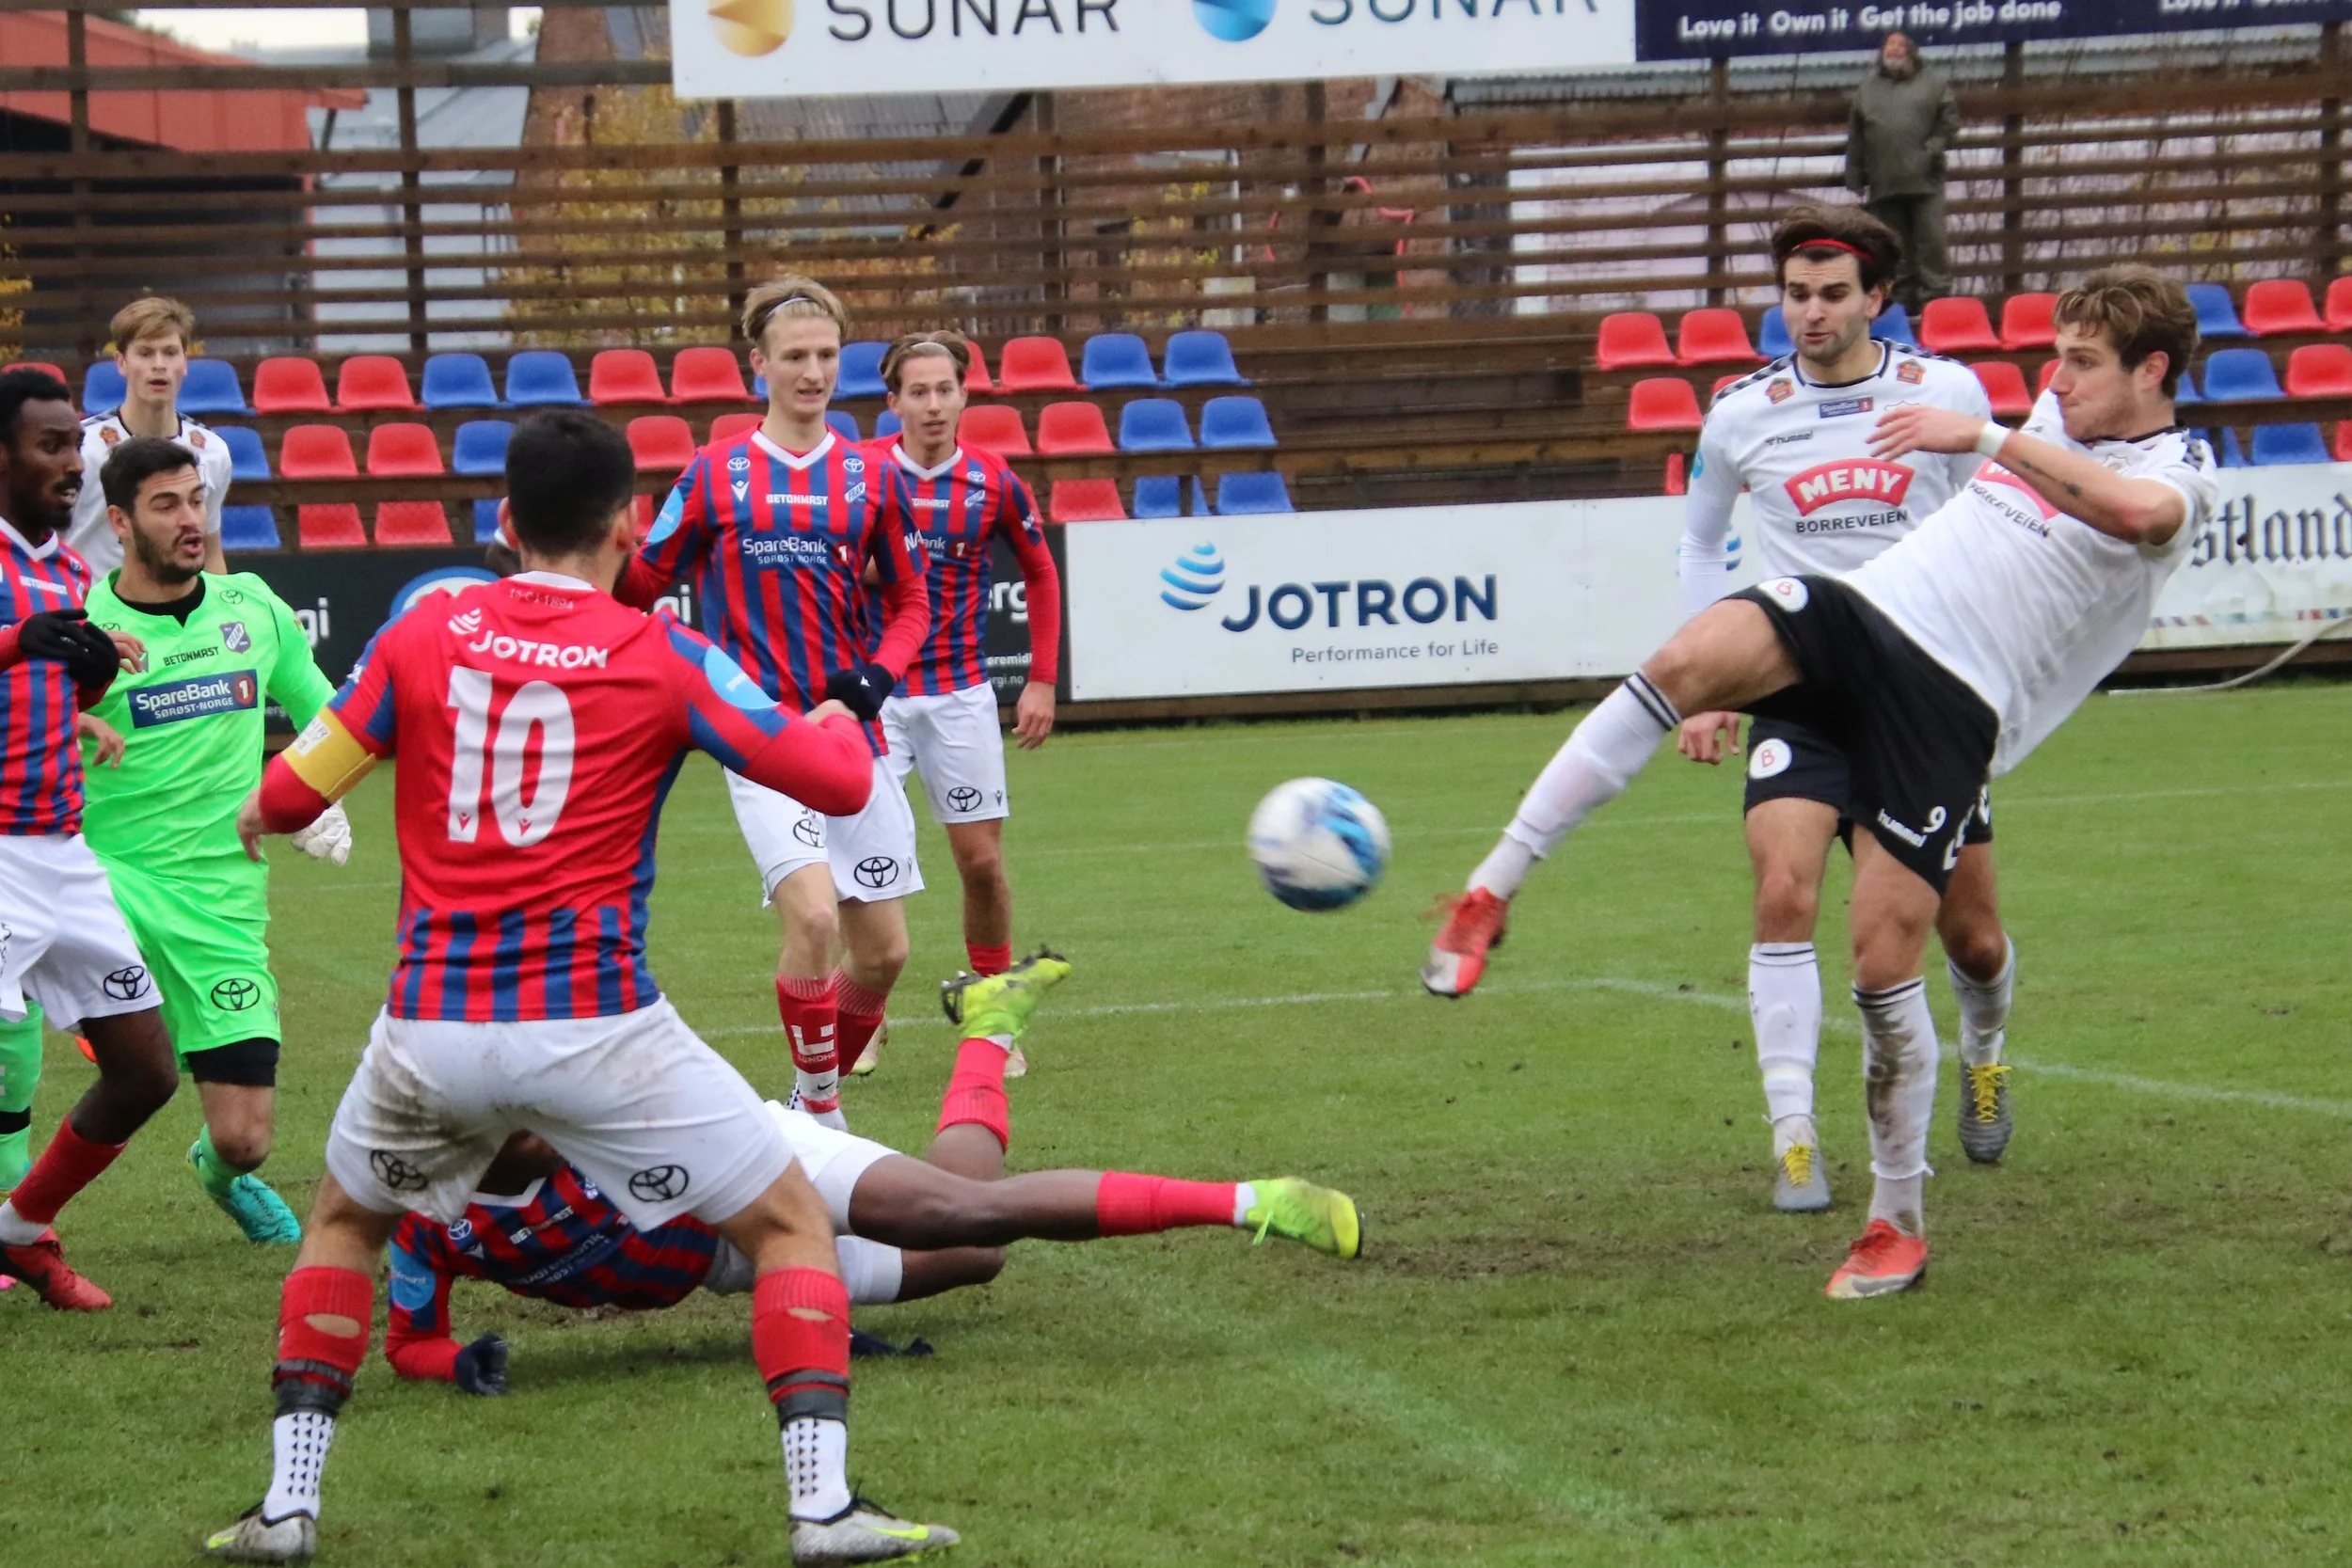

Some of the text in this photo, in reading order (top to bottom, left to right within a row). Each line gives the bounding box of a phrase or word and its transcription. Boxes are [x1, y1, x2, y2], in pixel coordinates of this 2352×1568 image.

[1679, 0, 2061, 38] Love it Own it Get the job done
[1797, 467, 1902, 503] MENY
[766, 494, 829, 506] BETONMAST
[1796, 510, 1907, 533] BORREVEIEN
[742, 536, 848, 562] SpareBank 1
[1221, 574, 1498, 632] JOTRON
[163, 646, 219, 666] BETONMAST
[469, 630, 609, 669] JOTRON
[1292, 639, 1499, 663] Performance for Life
[135, 679, 248, 711] SpareBank 1
[154, 697, 234, 719] SØRØST-NORGE
[447, 664, 575, 847] 10
[1923, 806, 1947, 832] 9
